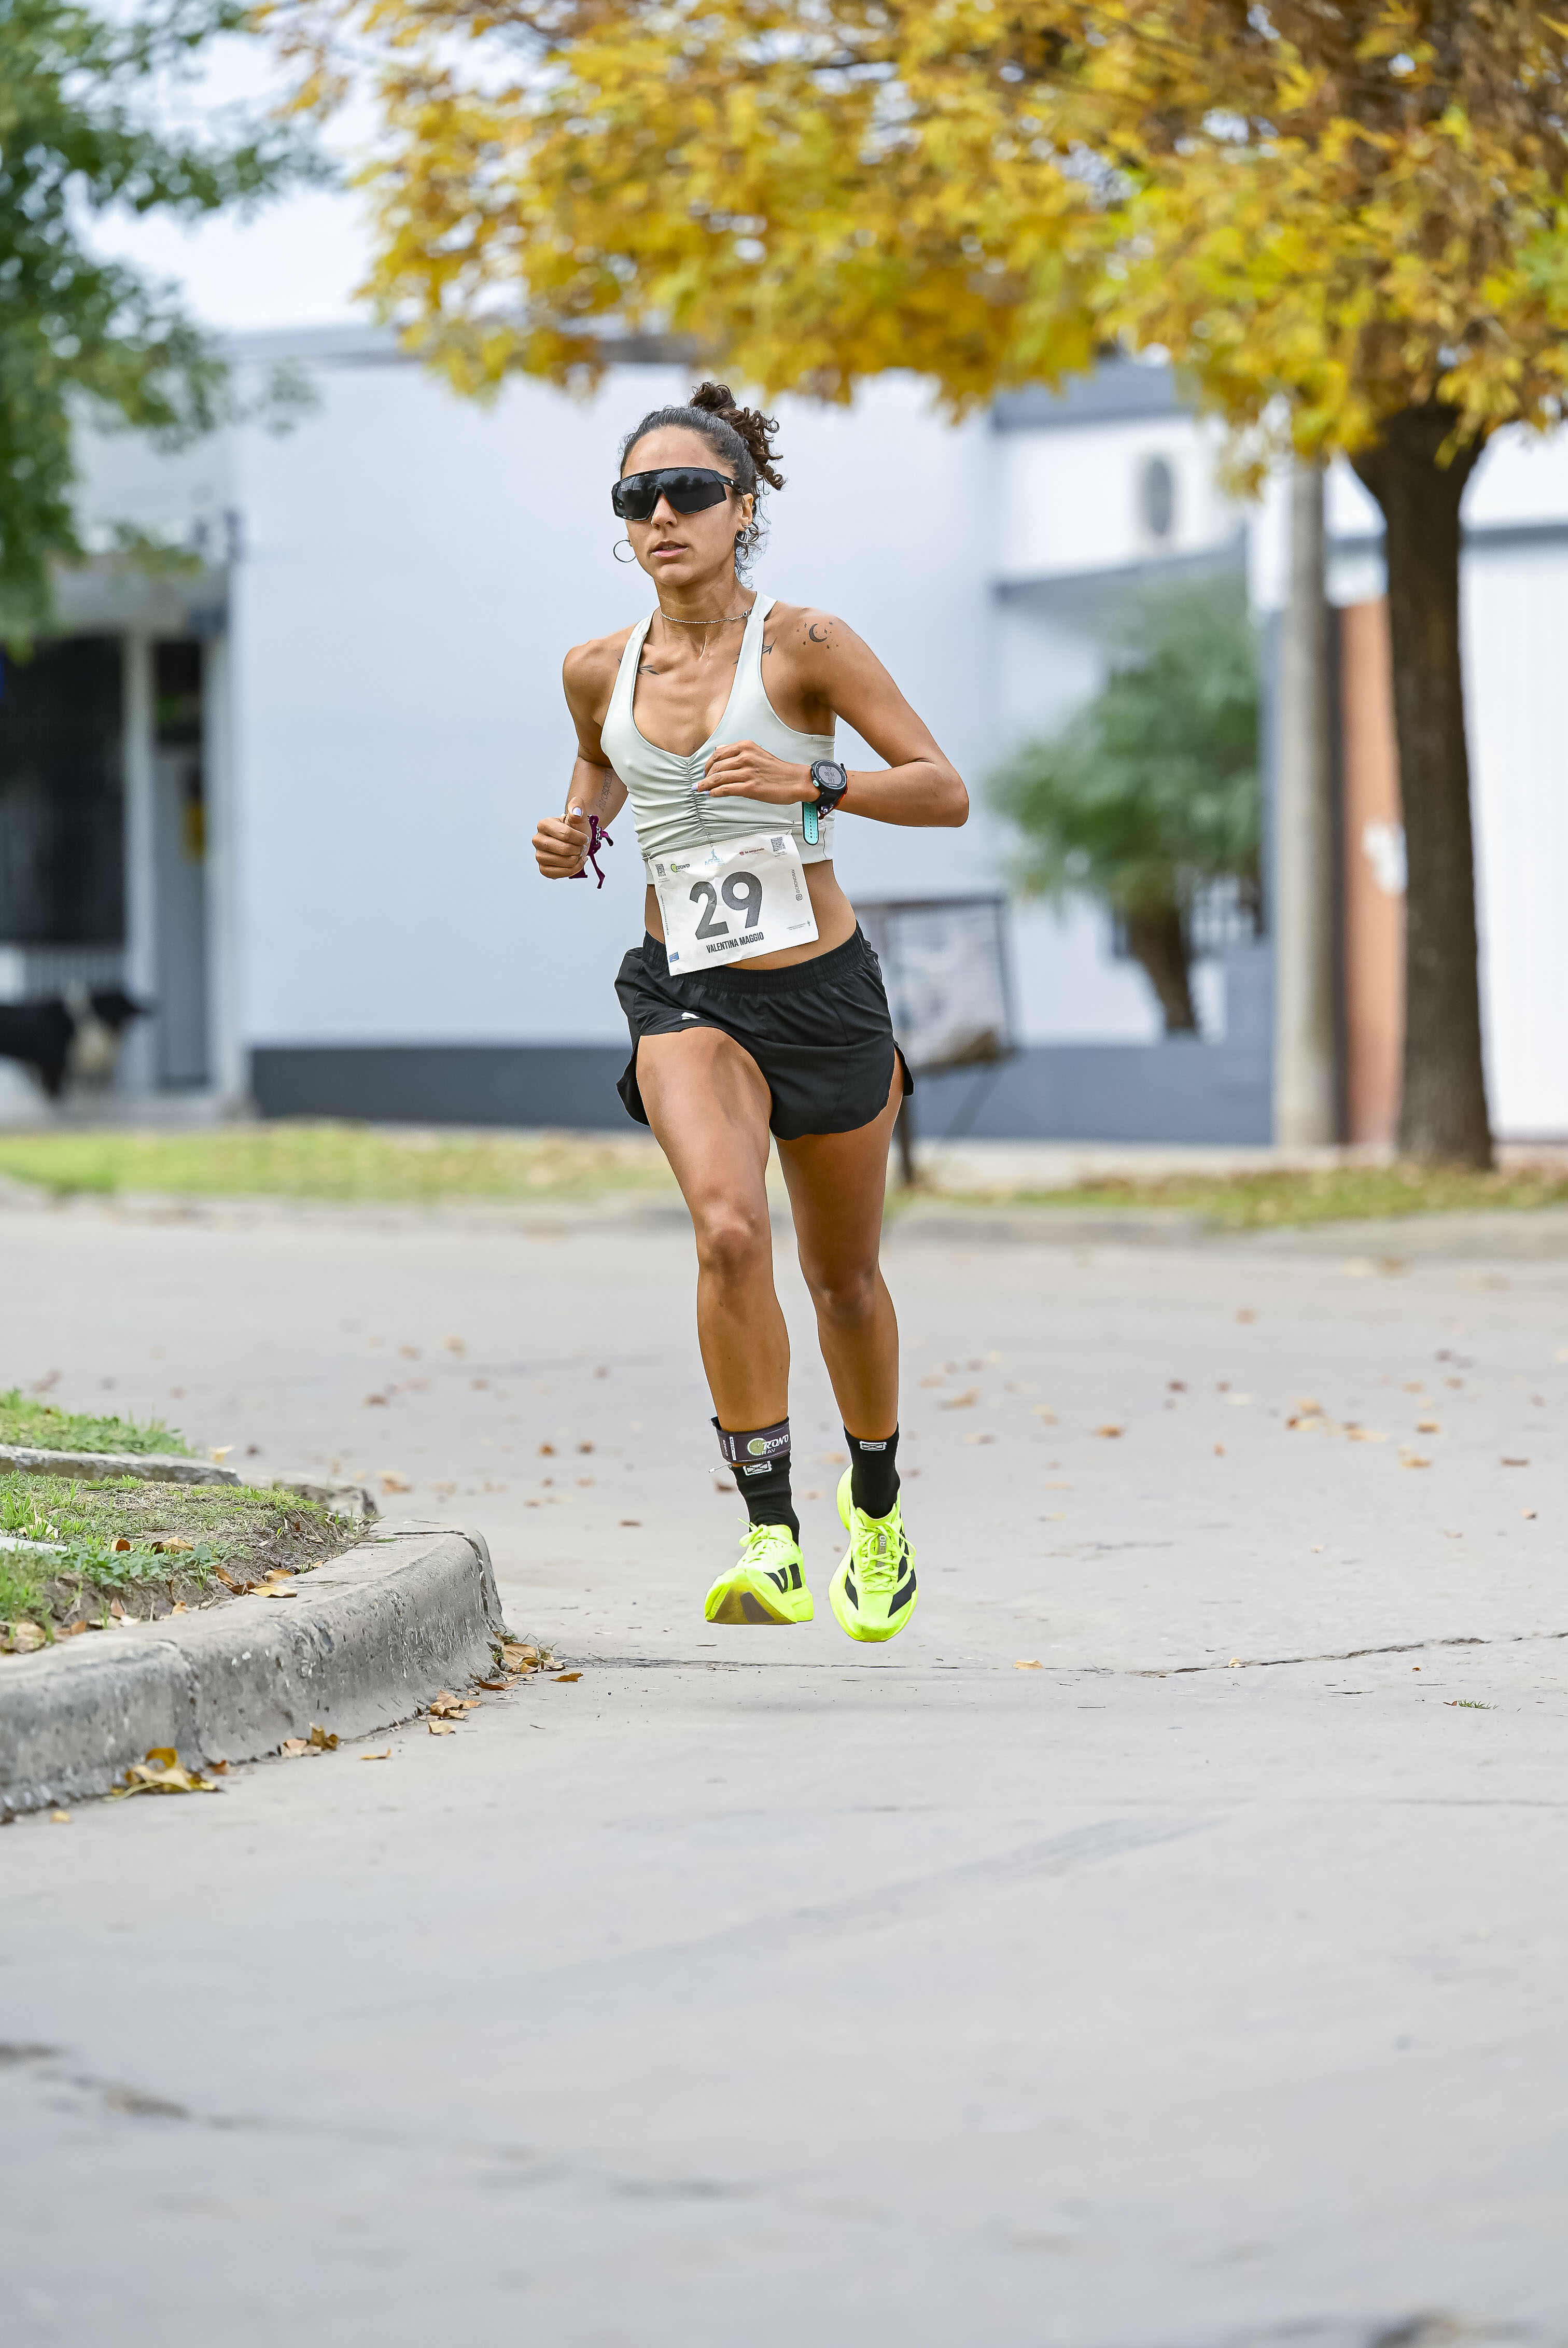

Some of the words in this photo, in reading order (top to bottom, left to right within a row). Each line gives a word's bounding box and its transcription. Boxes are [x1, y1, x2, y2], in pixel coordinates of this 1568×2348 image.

[689, 871, 763, 940] 29
[706, 939, 739, 954] VALENTINA
[738, 932, 764, 946] MAGGIO
